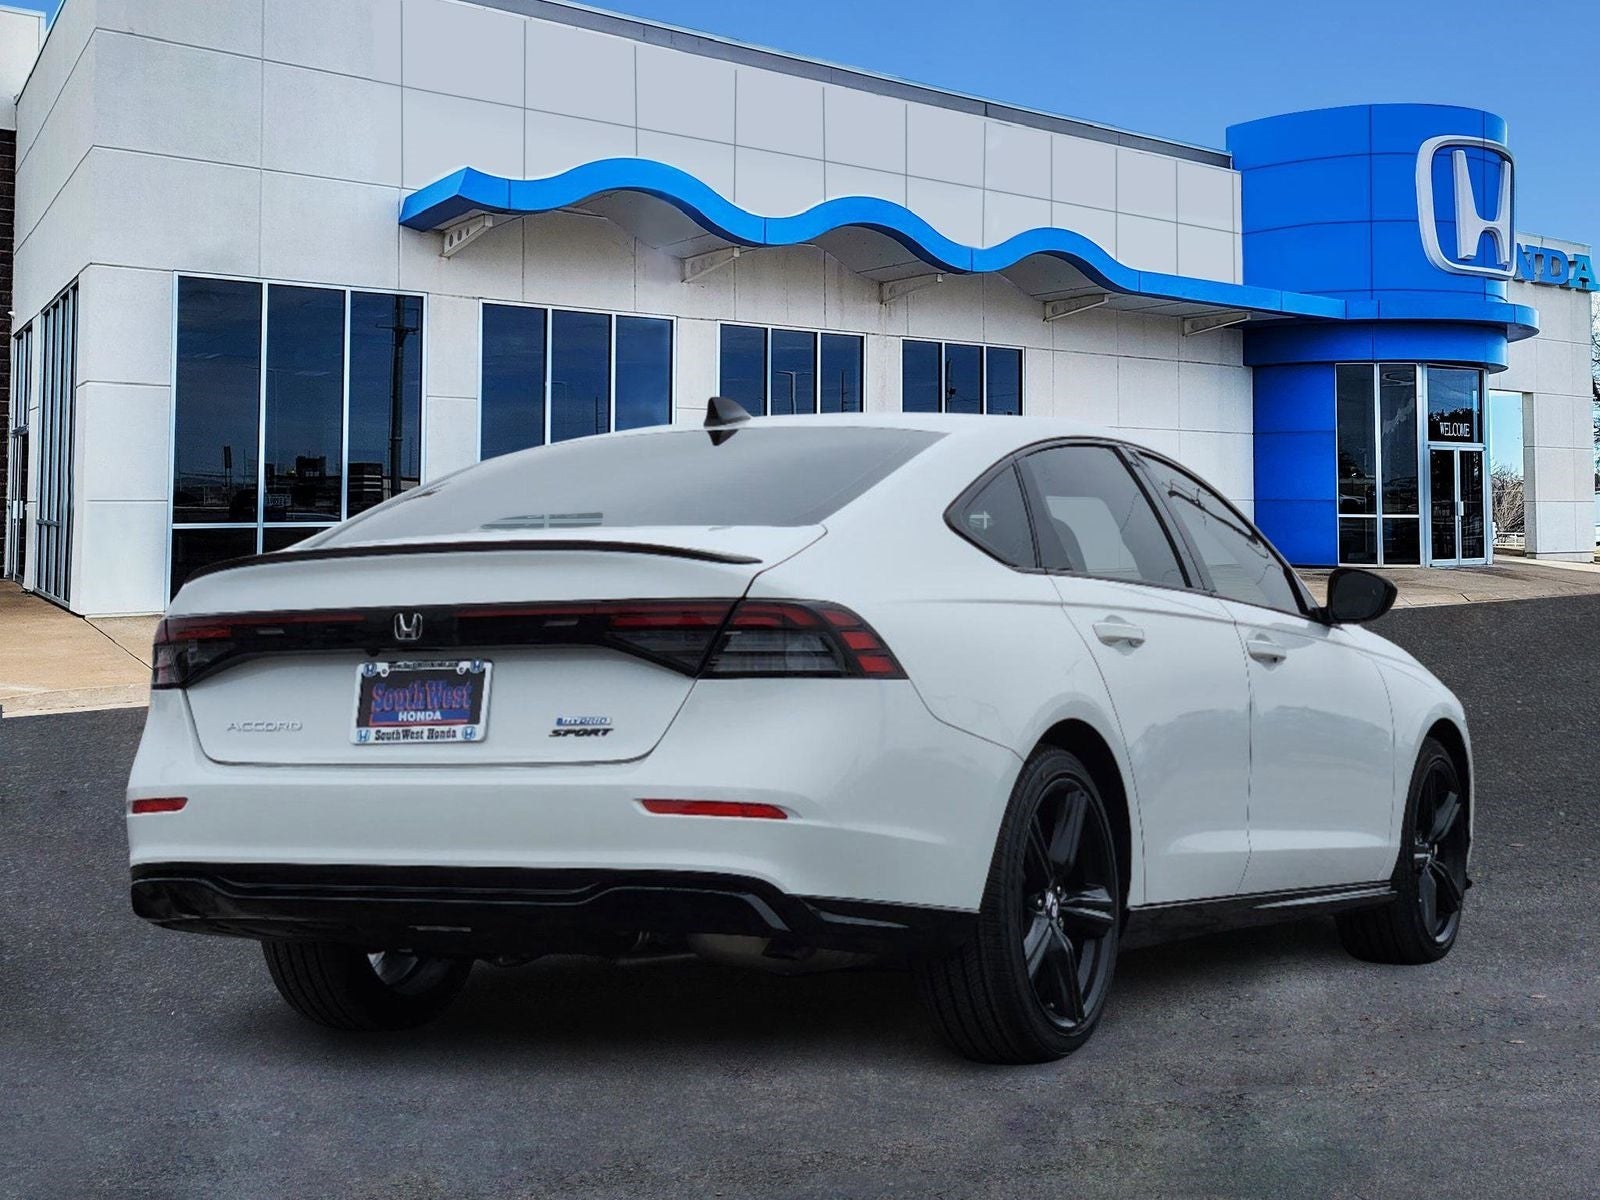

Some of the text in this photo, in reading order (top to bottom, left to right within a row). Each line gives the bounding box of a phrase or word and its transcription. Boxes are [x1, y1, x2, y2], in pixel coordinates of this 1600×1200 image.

[1440, 422, 1470, 437] WELCOME
[398, 711, 442, 722] HONDA
[563, 716, 610, 727] HYBRID
[226, 721, 303, 733] ACCORD
[548, 728, 614, 737] SPORT
[427, 728, 457, 739] Honda
